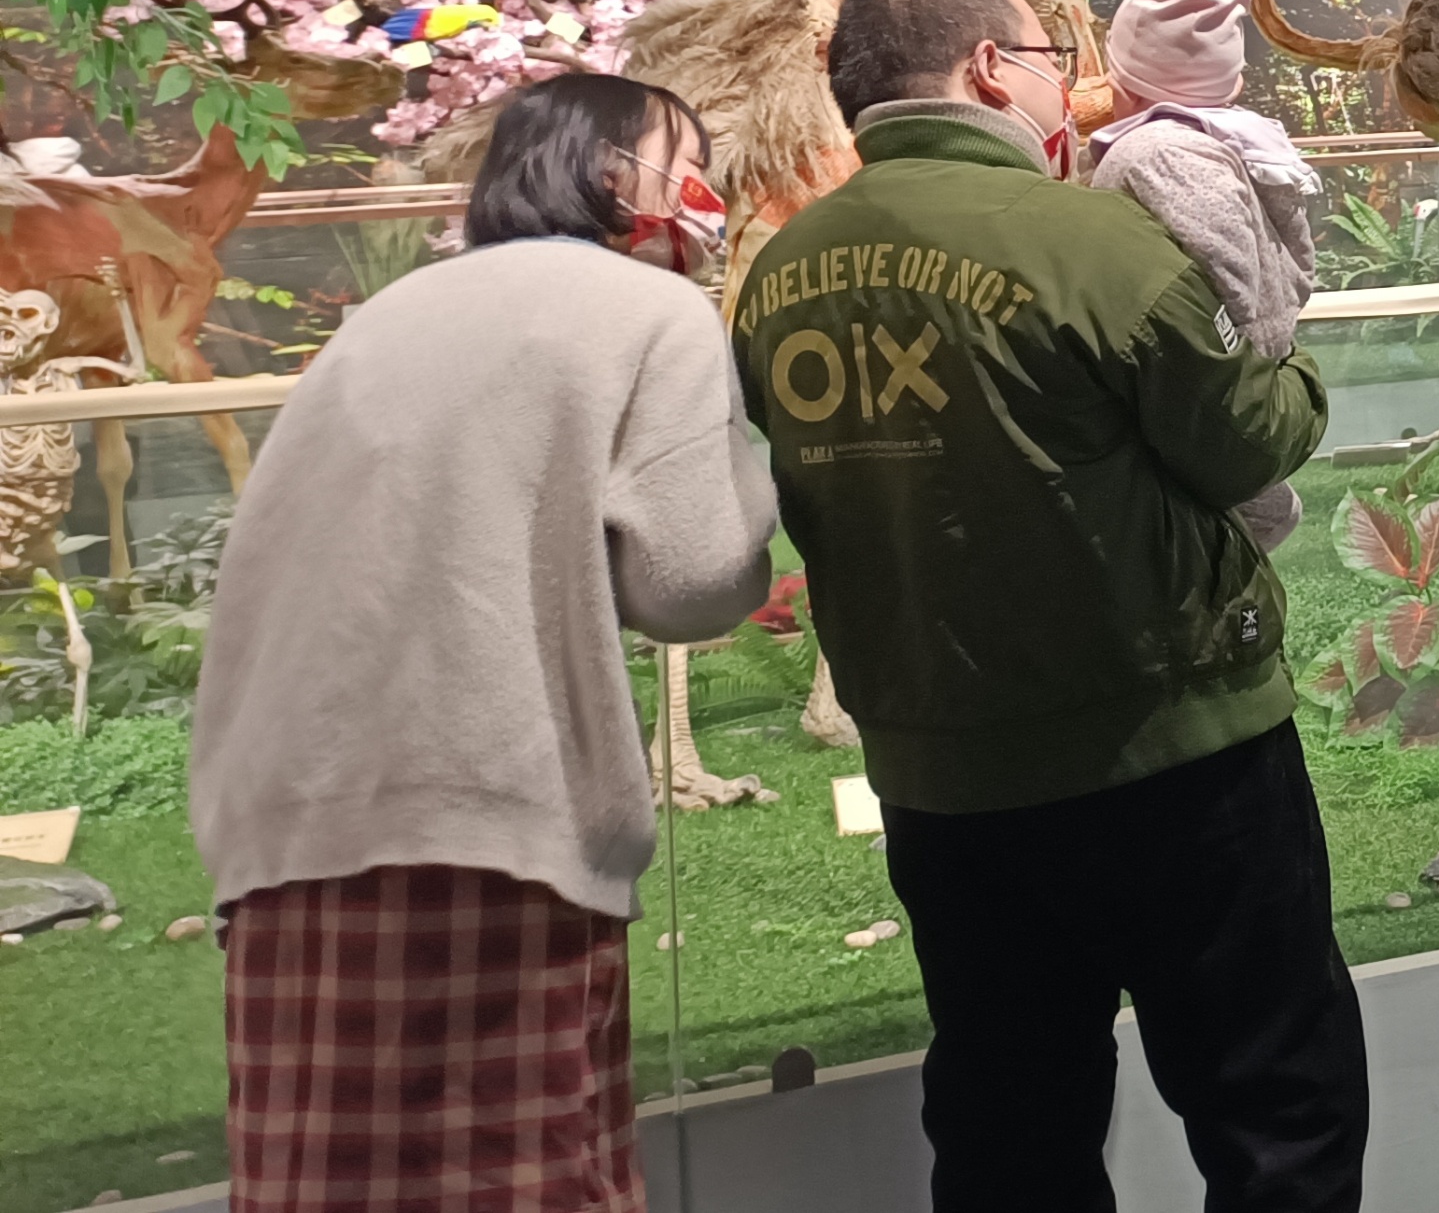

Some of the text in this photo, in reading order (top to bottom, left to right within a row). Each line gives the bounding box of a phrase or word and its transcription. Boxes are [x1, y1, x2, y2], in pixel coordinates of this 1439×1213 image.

[762, 243, 894, 317] BELIEVE
[898, 246, 948, 294] OR
[946, 258, 1034, 326] NOT
